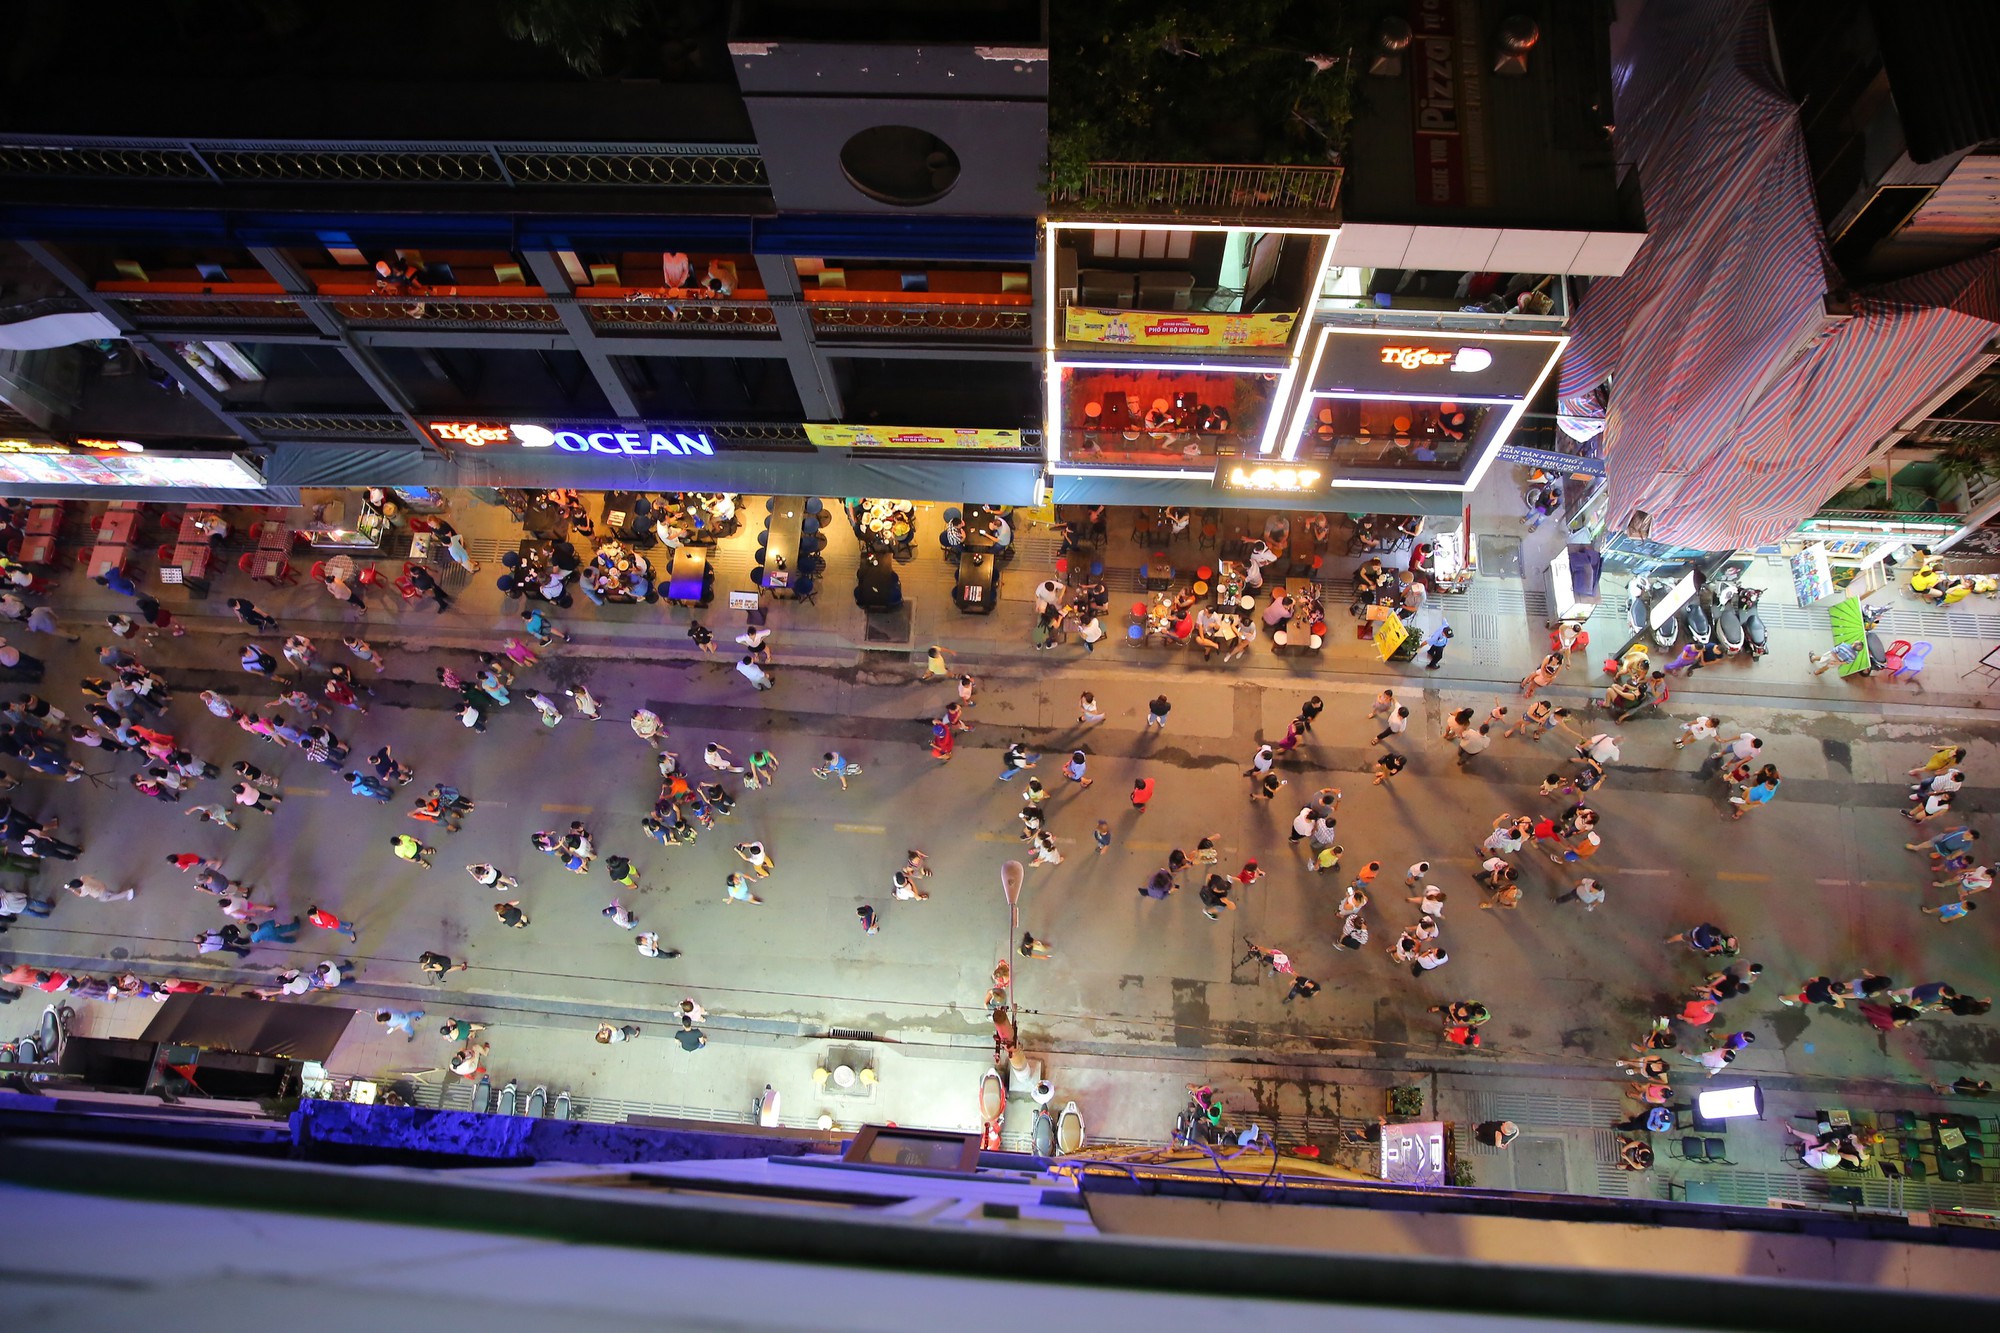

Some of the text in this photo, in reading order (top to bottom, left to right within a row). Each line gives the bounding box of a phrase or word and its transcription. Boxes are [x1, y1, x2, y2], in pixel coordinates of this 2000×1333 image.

[1420, 39, 1456, 130] Pizza
[1429, 138, 1449, 164] YOUR
[1431, 167, 1450, 201] CREATE
[1381, 346, 1452, 370] Tiger
[430, 423, 508, 446] Tiger
[555, 431, 715, 456] OCEAN
